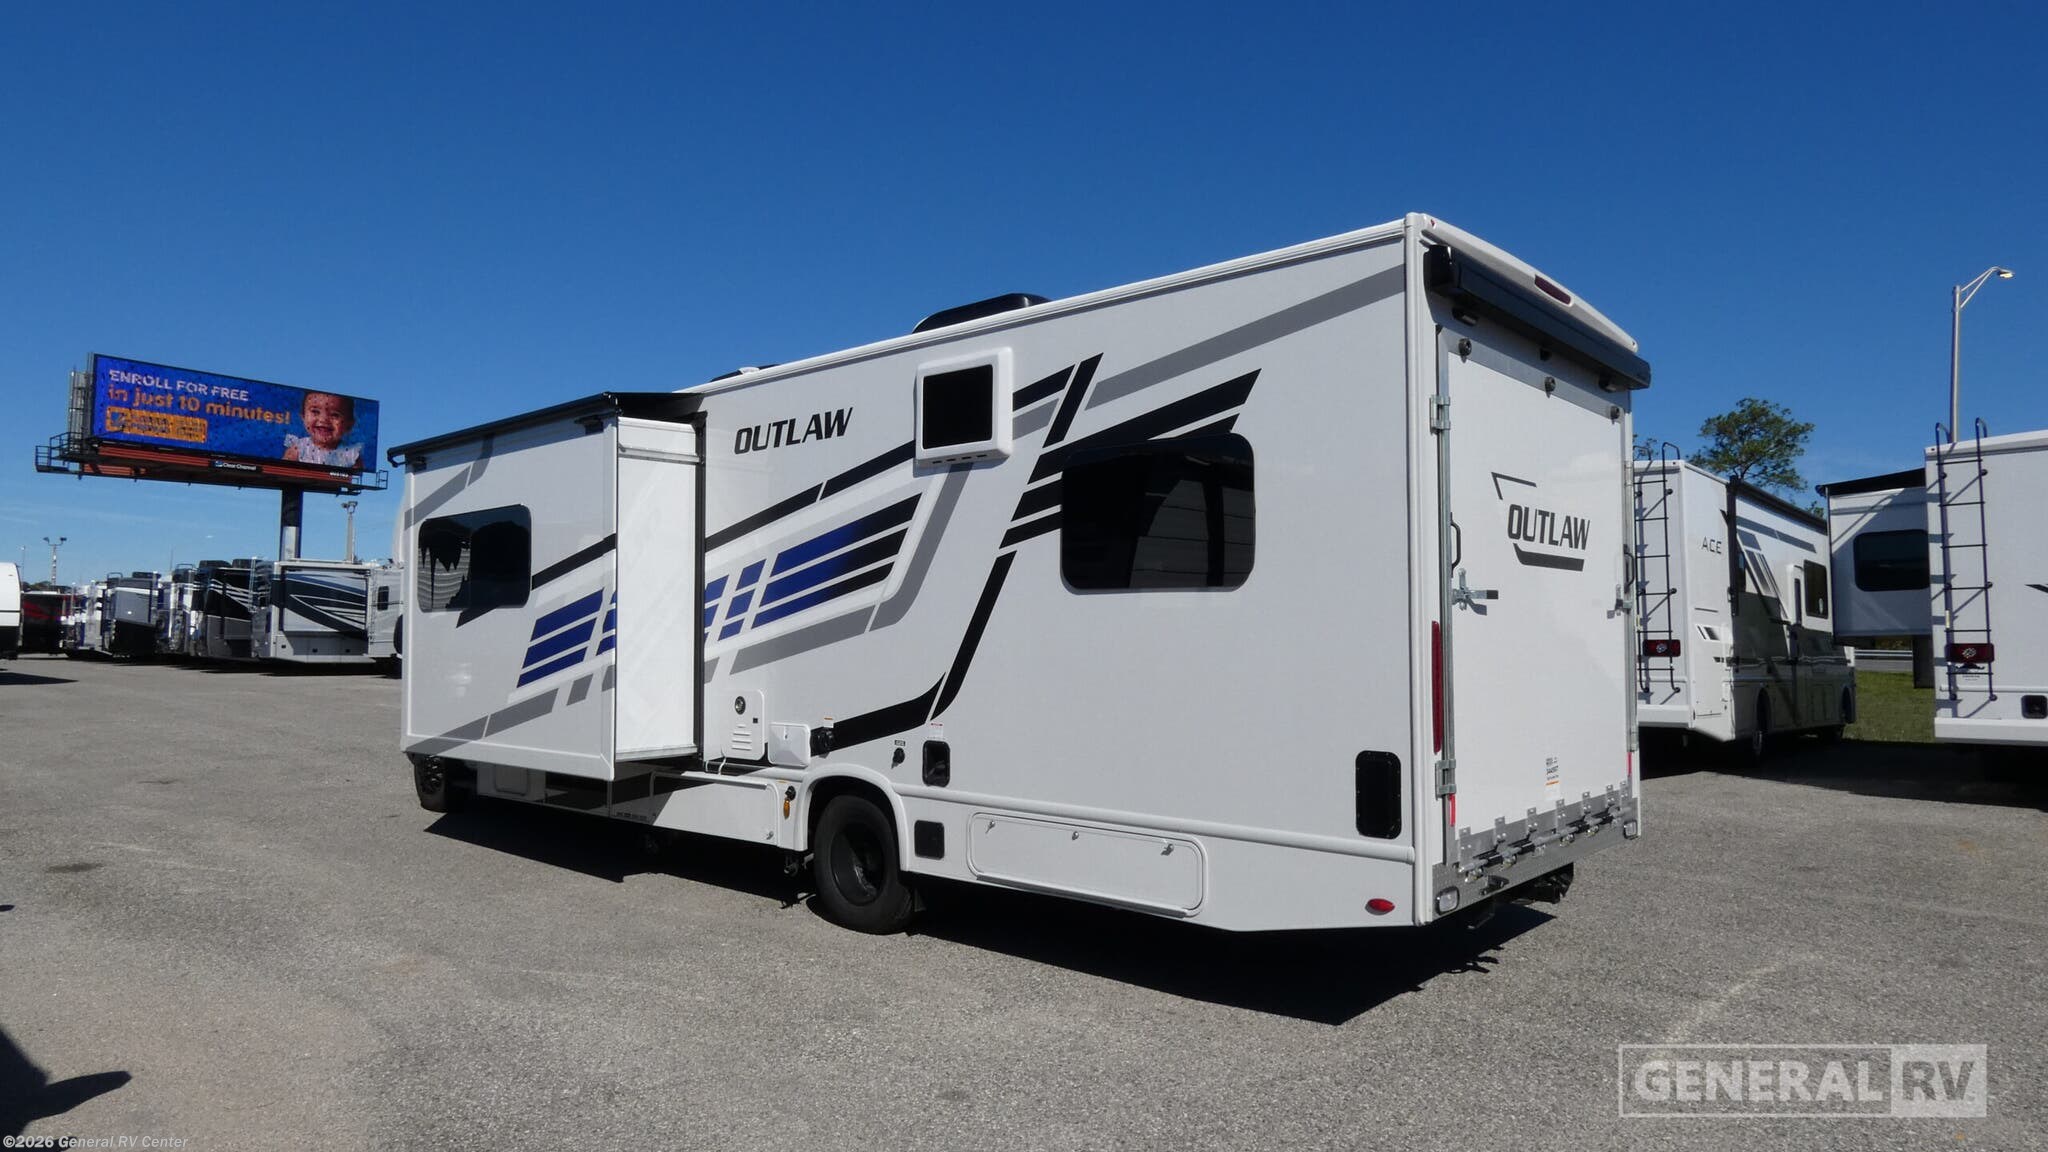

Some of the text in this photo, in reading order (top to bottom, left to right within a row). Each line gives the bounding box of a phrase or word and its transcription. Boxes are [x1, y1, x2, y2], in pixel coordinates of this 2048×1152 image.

[108, 383, 291, 425] in just 10 minutes!
[109, 369, 249, 401] ENROLL FOR FREE
[734, 407, 853, 454] OUTLAW
[1507, 504, 1591, 550] OUTLAW
[1701, 535, 1722, 555] ACE
